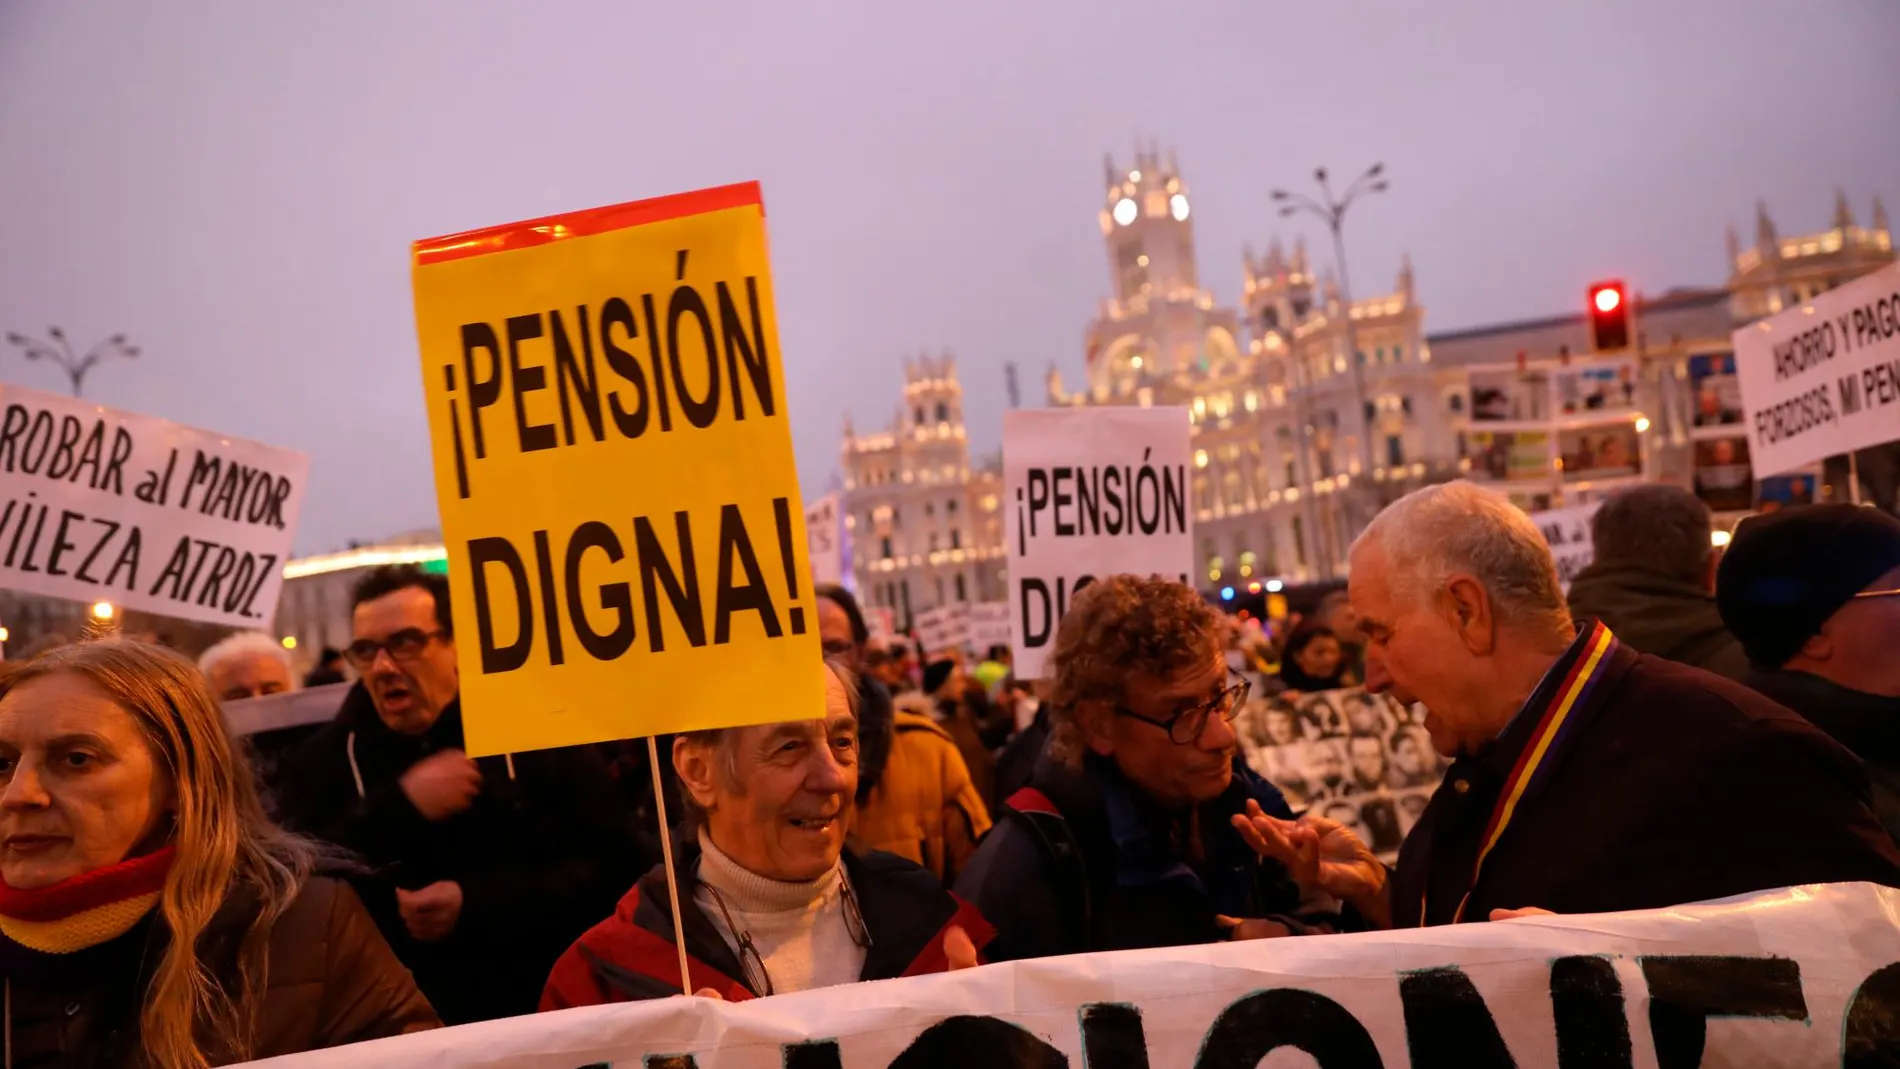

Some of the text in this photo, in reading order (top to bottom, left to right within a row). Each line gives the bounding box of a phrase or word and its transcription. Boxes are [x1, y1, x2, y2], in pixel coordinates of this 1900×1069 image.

[444, 249, 776, 499] ¡PENSIÓN
[1773, 320, 1836, 382] AHORRO
[1837, 312, 1850, 354] Y
[0, 404, 133, 496] ROBAR
[134, 448, 177, 506] al
[1754, 383, 1838, 448] FORZOSOS,
[1837, 373, 1861, 417] MI
[1017, 447, 1186, 556] ¡PENSIÓN
[149, 535, 278, 619] ATROZ.
[468, 497, 807, 675] DIGNA!
